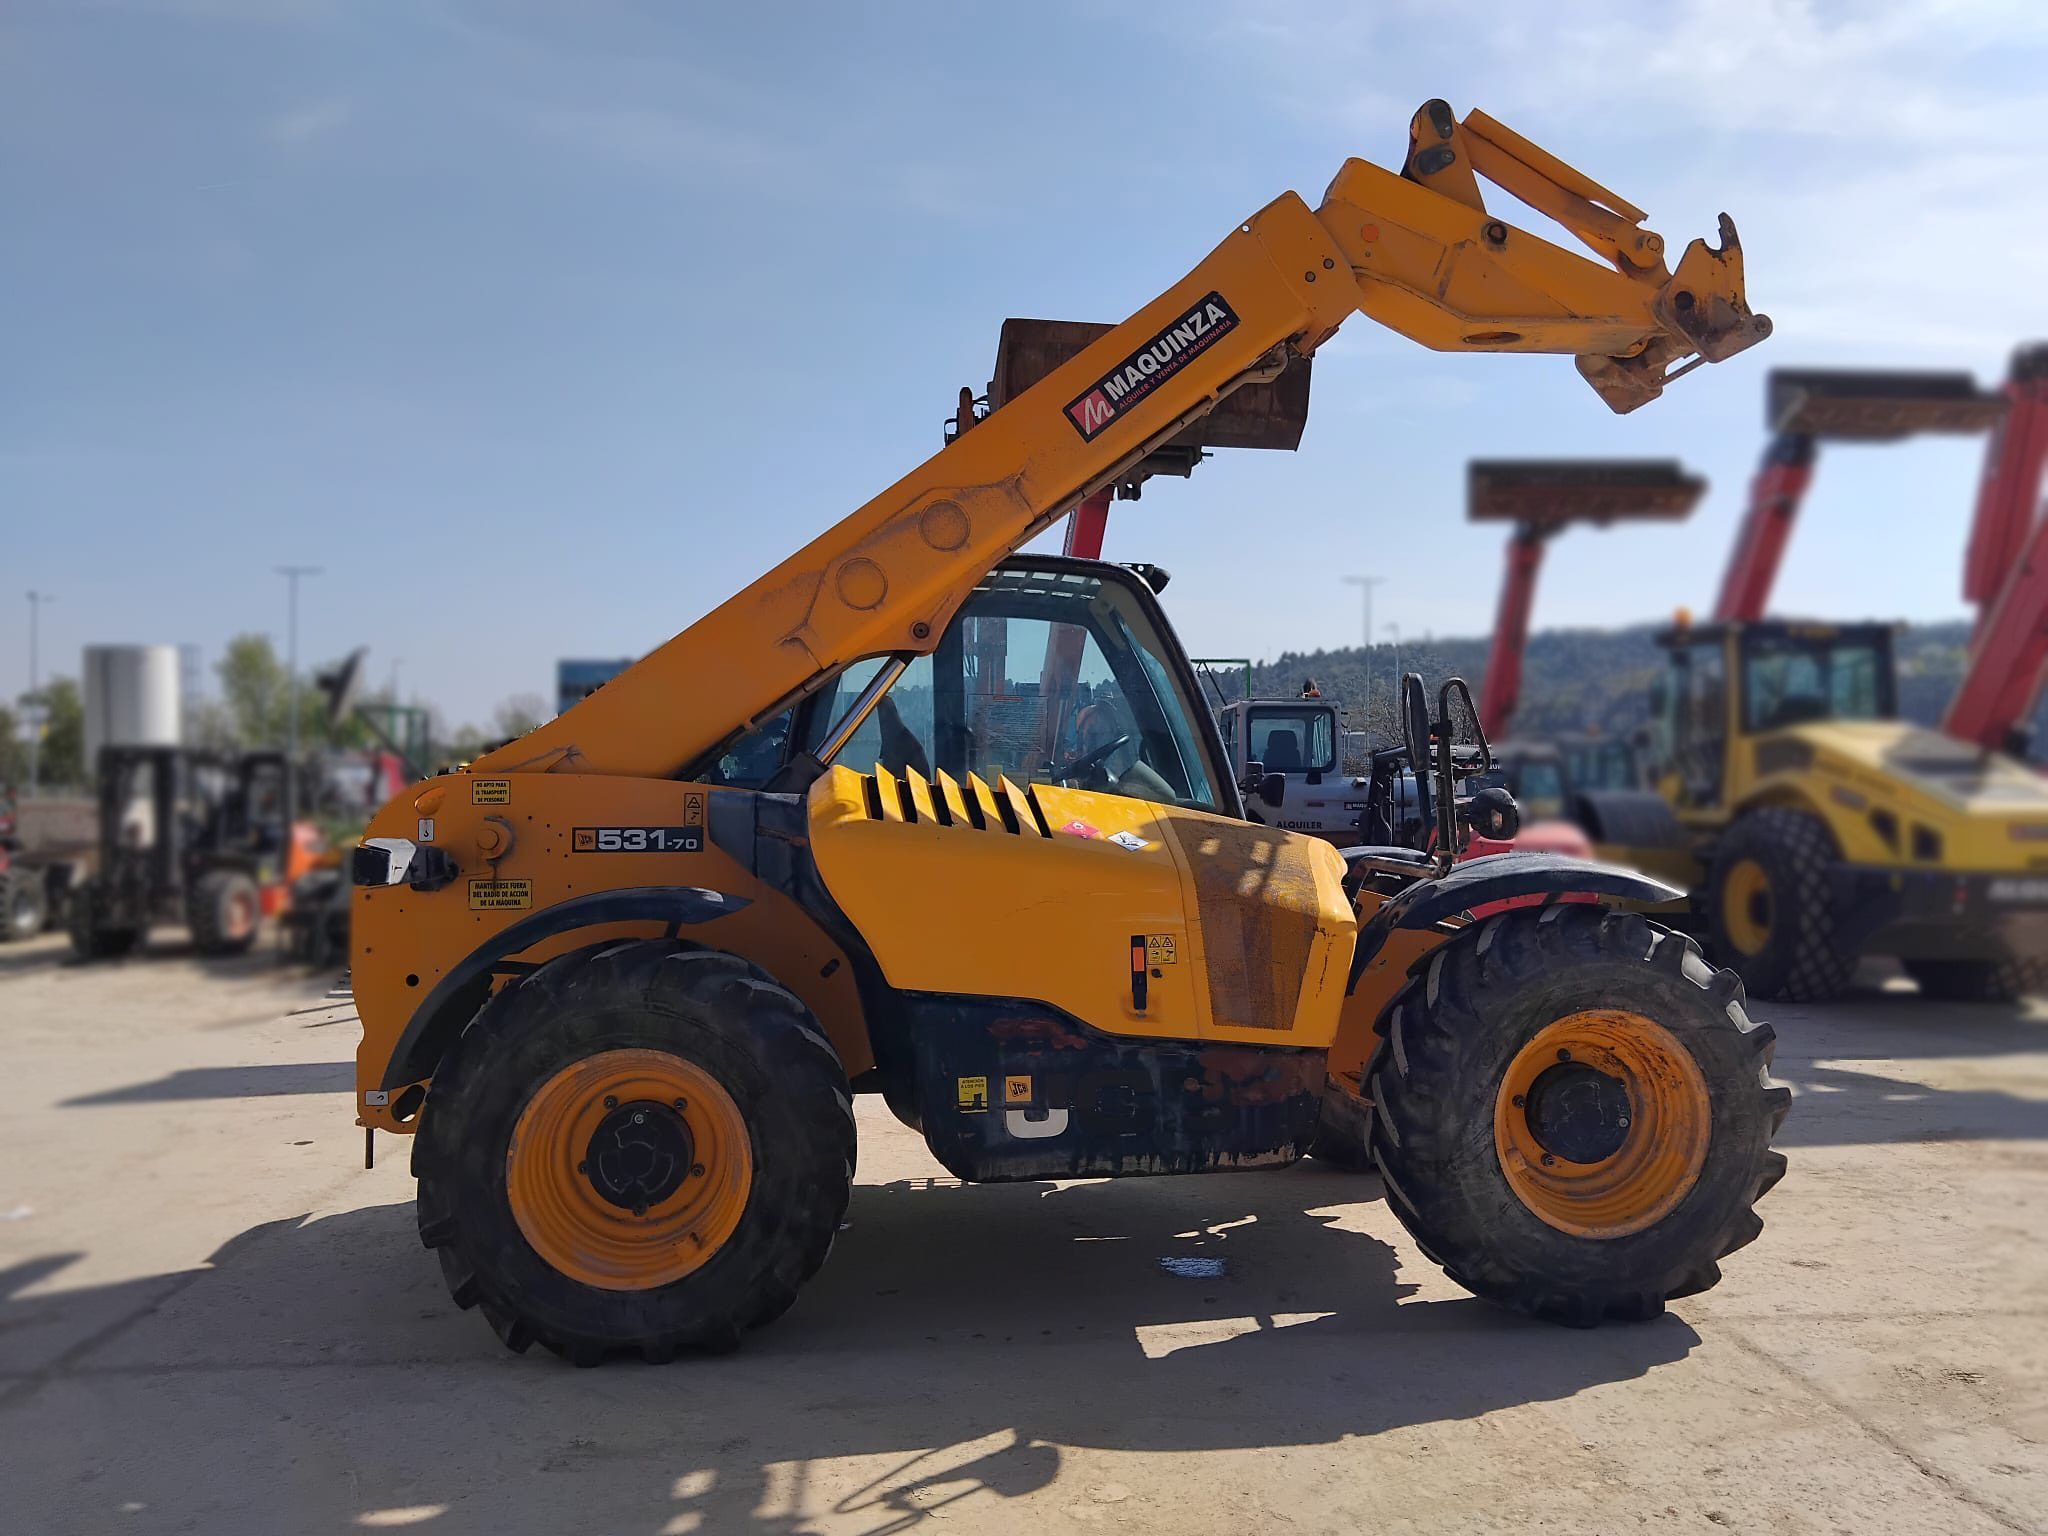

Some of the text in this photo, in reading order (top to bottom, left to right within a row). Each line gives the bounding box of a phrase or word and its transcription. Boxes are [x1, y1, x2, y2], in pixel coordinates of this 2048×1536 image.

[1103, 302, 1227, 401] MAQUINZA
[1119, 319, 1233, 410] ALQUILER Y VENTA DE MAQUINARIA
[1276, 820, 1323, 830] ALQUILER
[598, 829, 698, 850] 531-70
[483, 890, 501, 898] RADIO
[501, 890, 509, 898] DE
[1008, 1081, 1028, 1097] JCB
